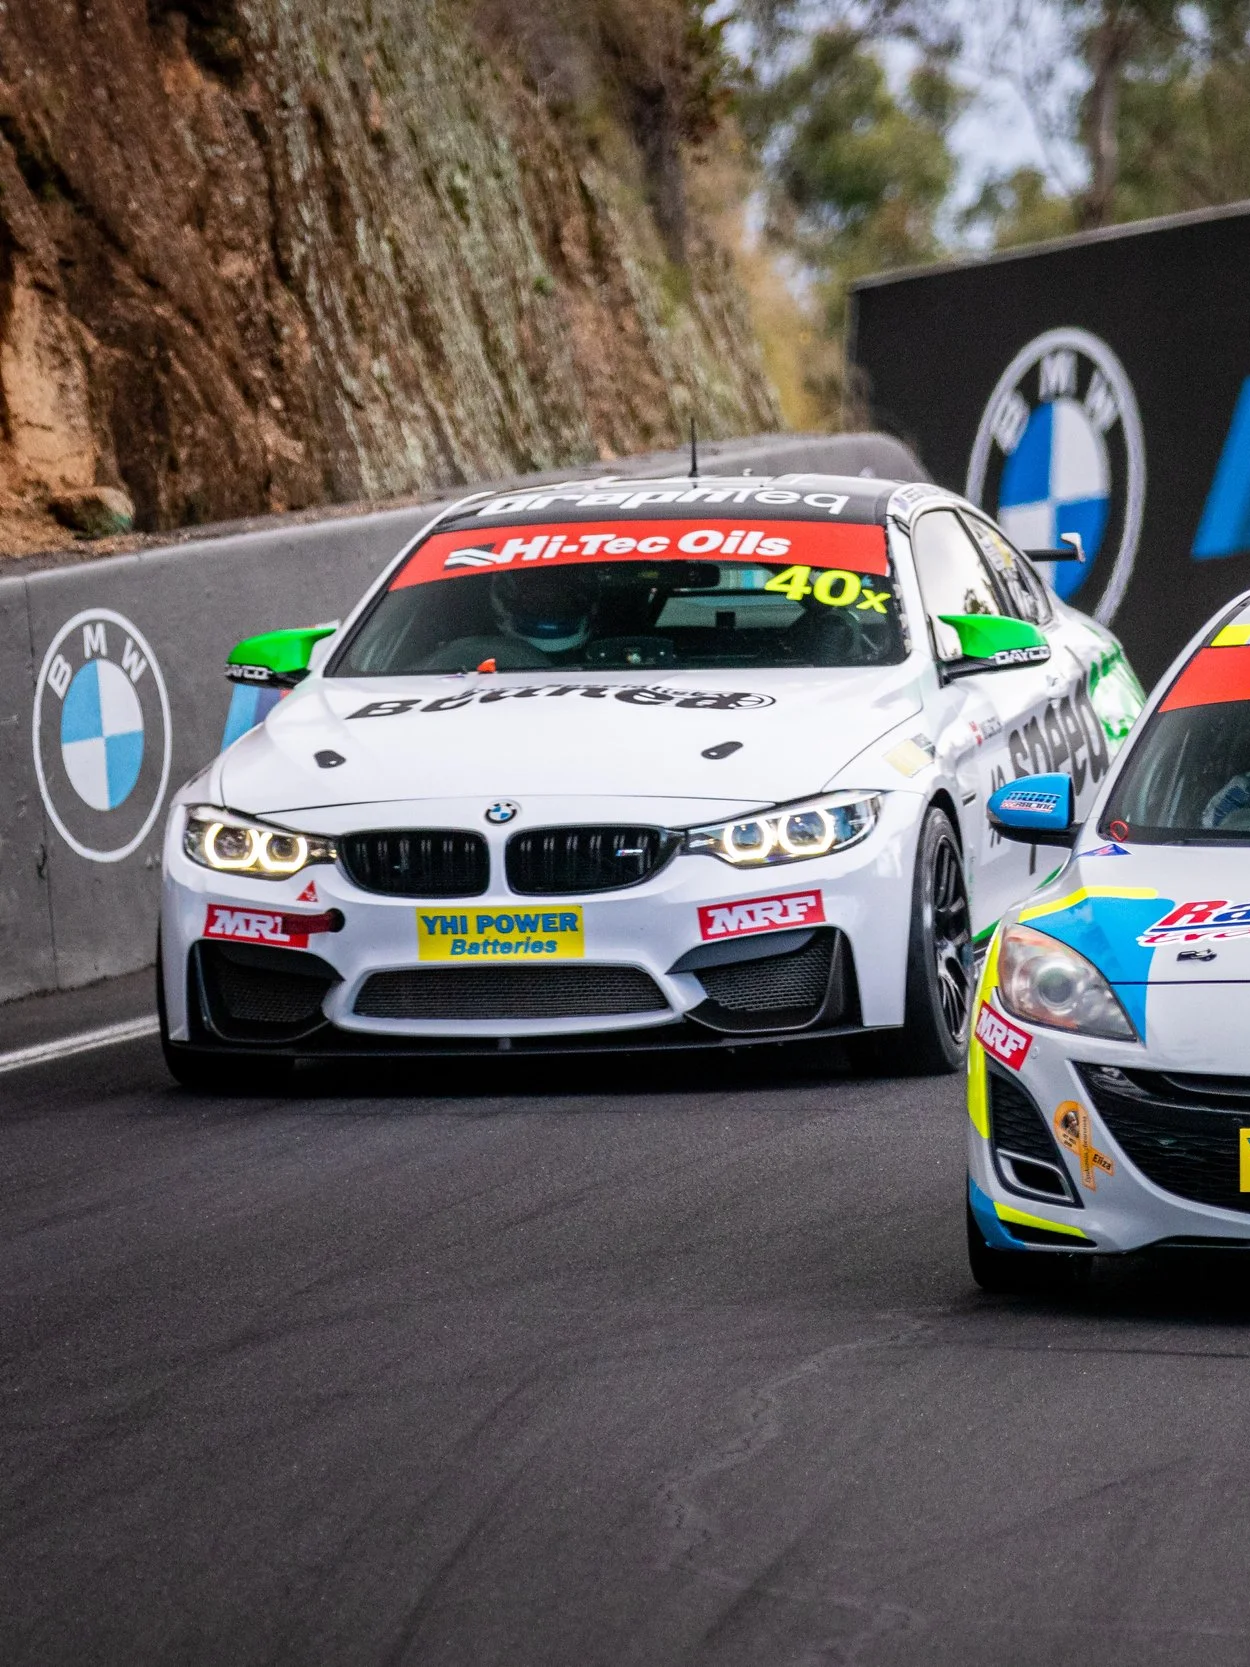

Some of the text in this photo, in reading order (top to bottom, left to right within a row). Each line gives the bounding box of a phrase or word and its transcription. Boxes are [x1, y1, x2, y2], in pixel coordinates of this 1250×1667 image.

[992, 349, 1121, 455] BMW
[500, 530, 791, 563] Hi-Tec Oils
[47, 622, 147, 699] BMW
[995, 646, 1051, 666] DAYCO
[421, 912, 578, 936] YHI POWER
[707, 895, 816, 934] MRF
[449, 936, 558, 956] Batteries
[976, 1007, 1028, 1059] MRF
[1091, 1153, 1112, 1171] Eliza
